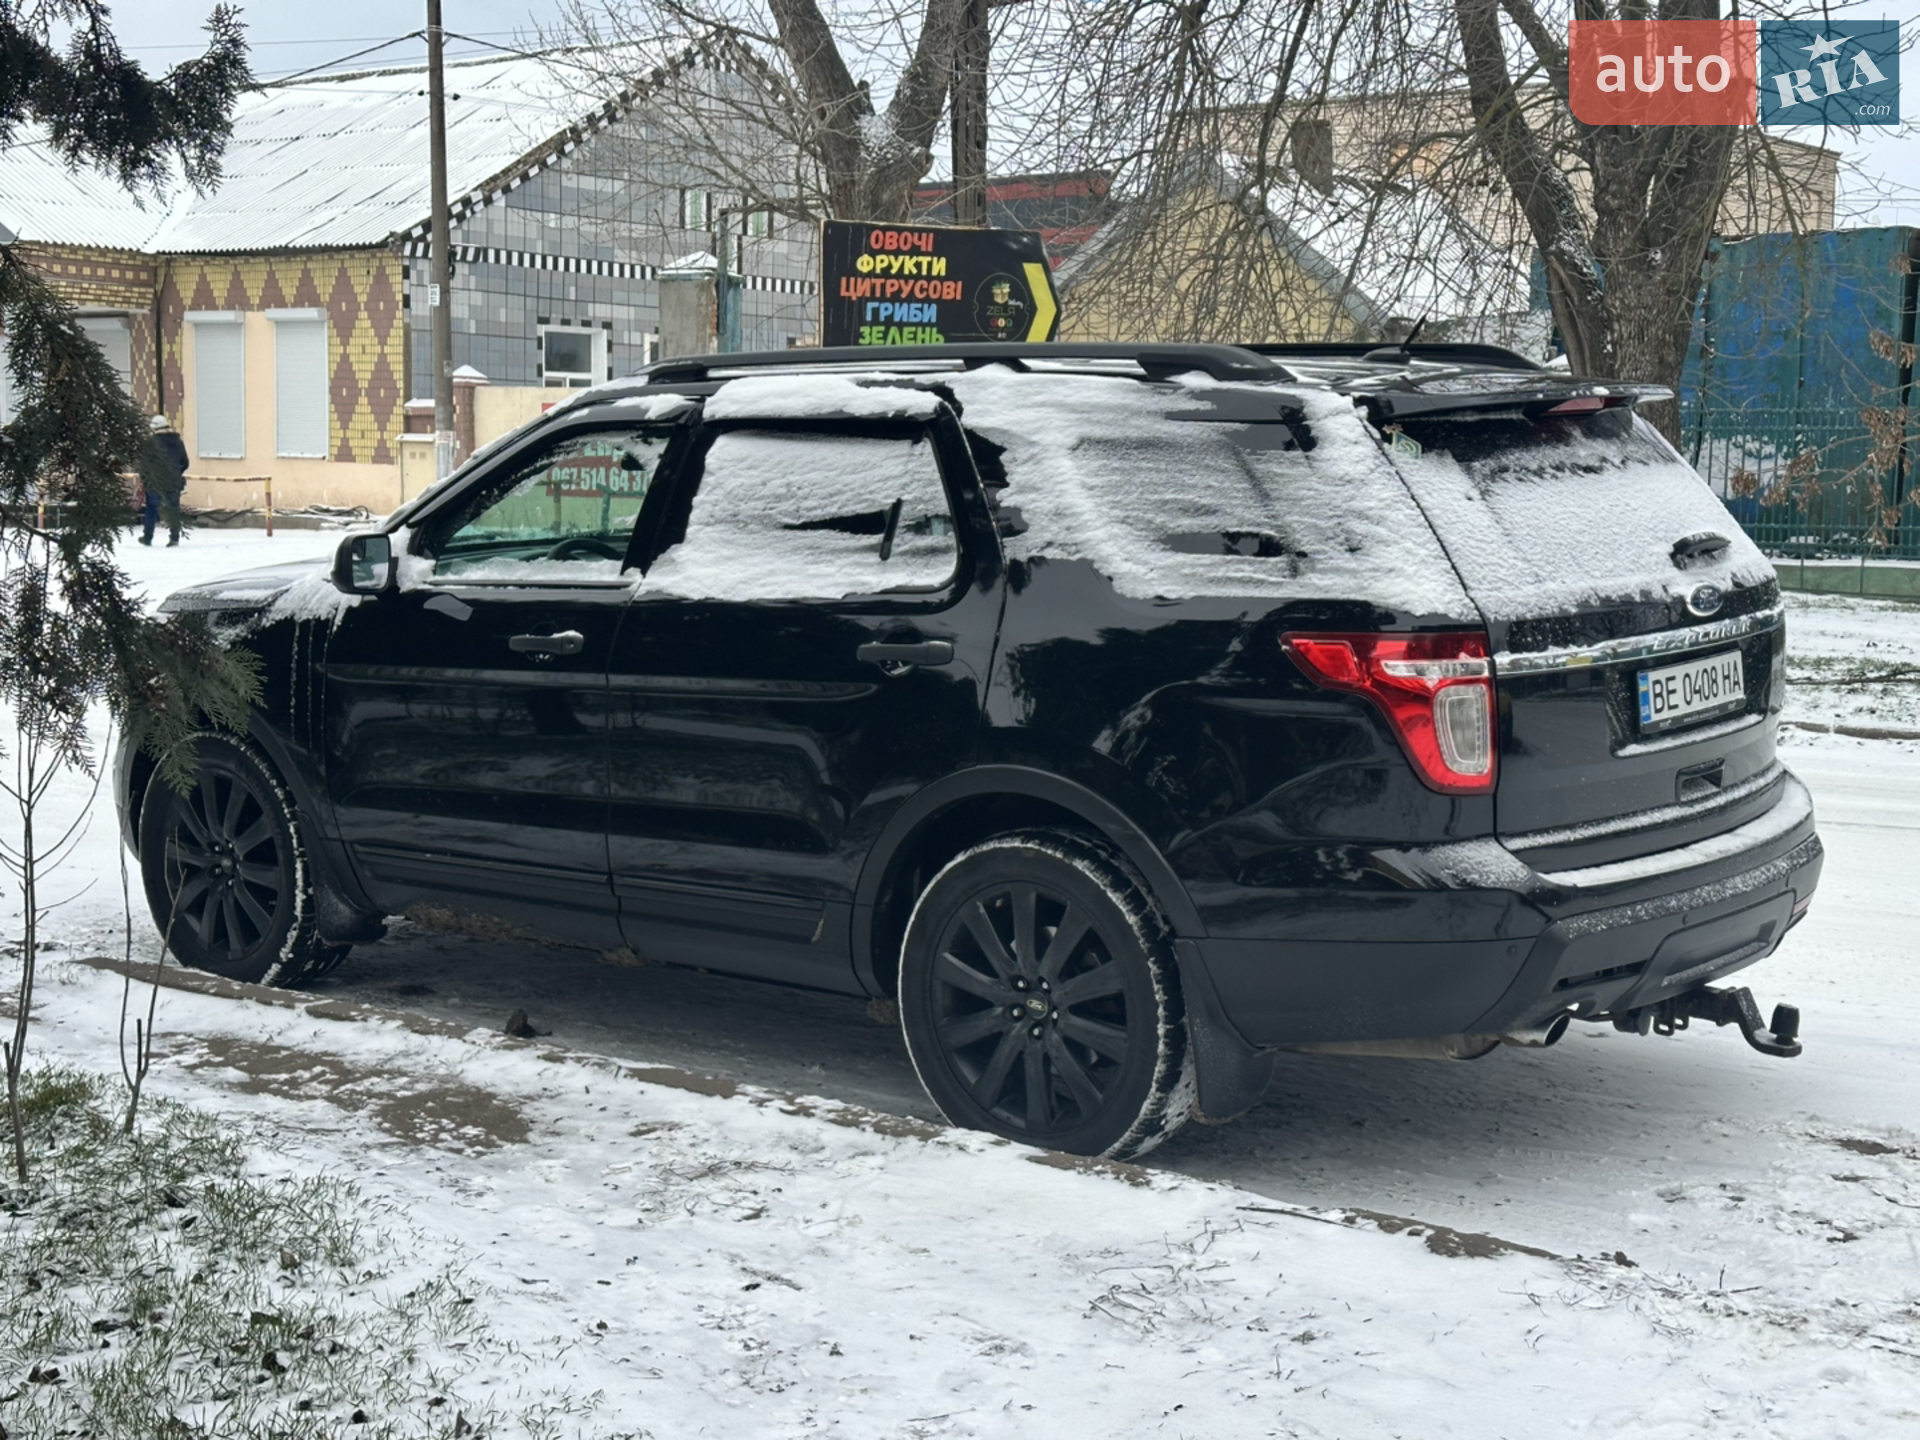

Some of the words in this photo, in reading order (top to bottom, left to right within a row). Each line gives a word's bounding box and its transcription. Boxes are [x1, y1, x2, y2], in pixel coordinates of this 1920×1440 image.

[869, 229, 935, 252] ОВОЧІ
[856, 253, 947, 276] ФРУКТИ
[839, 276, 963, 301] ЦИТРУСОВІ
[865, 302, 938, 324] ГРИБИ
[858, 325, 945, 345] ЗЕЛЕНЬ
[580, 466, 606, 491] 514
[1652, 676, 1679, 714] BE
[1682, 665, 1719, 706] 0408
[1721, 660, 1741, 696] HA
